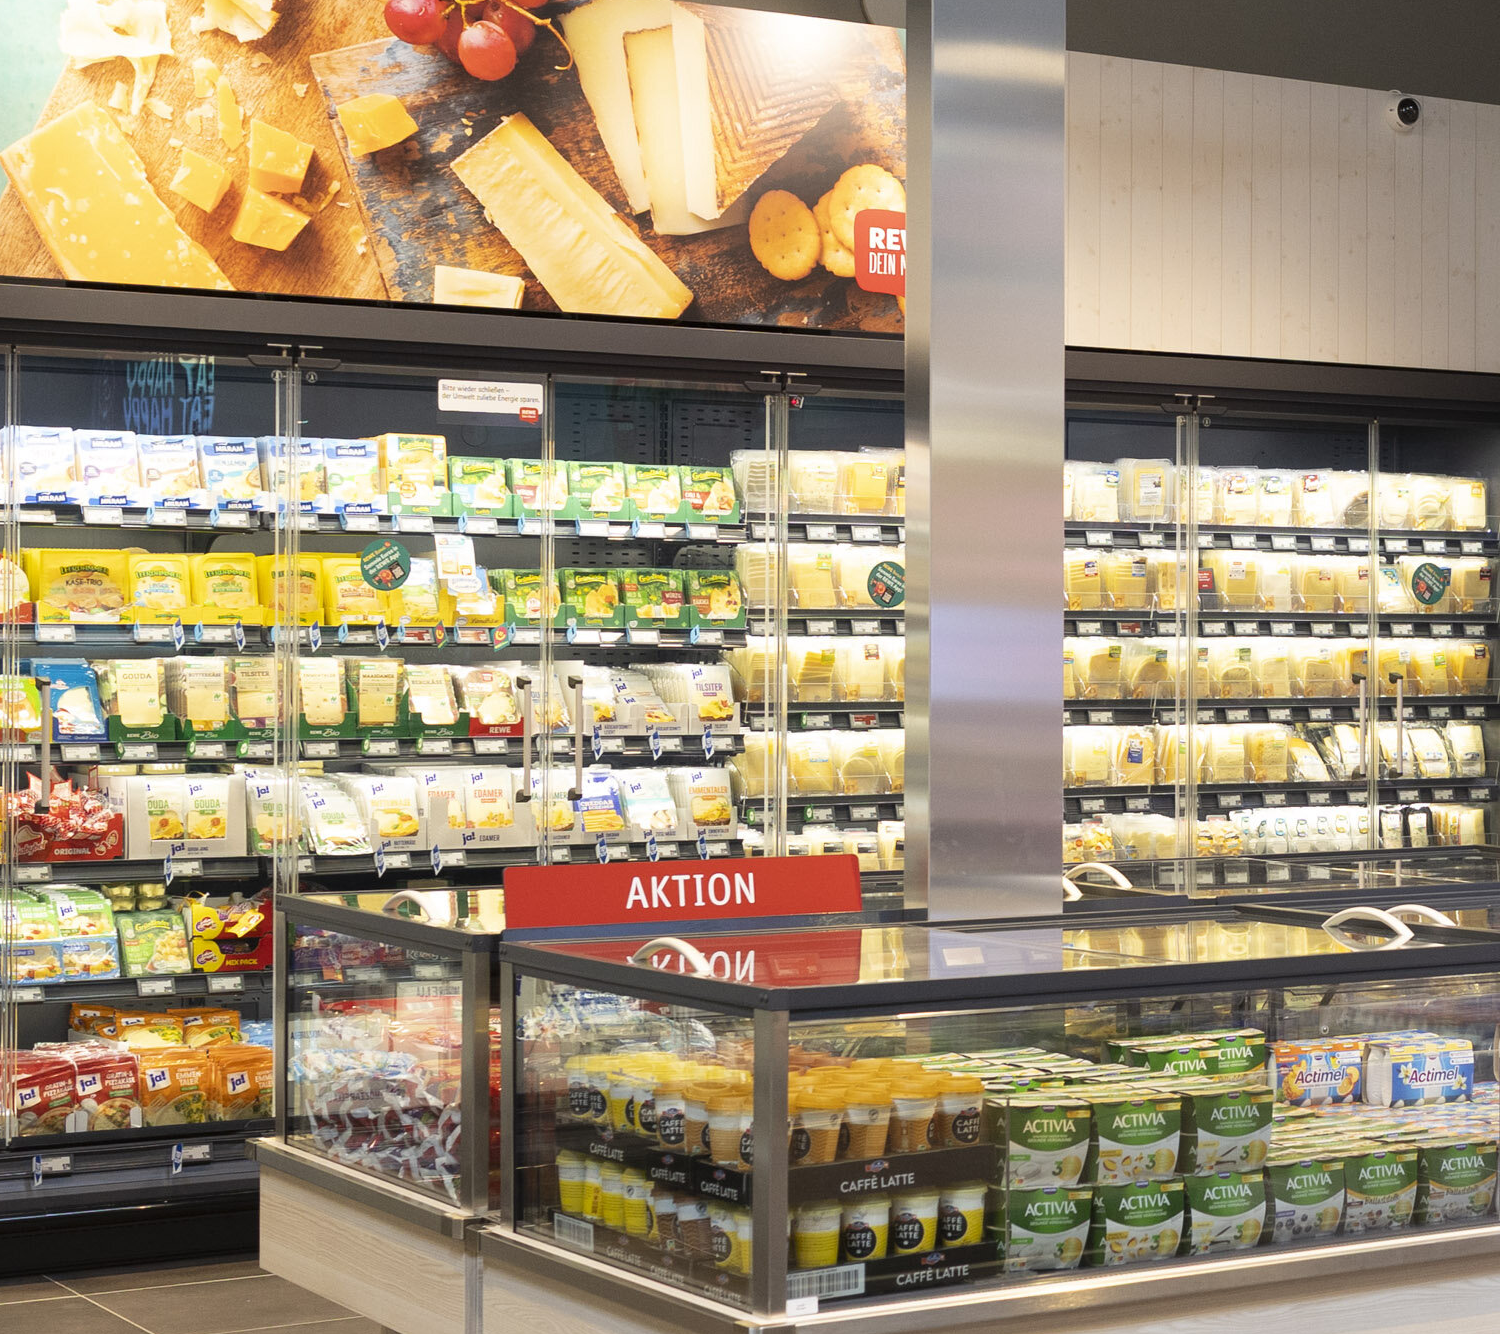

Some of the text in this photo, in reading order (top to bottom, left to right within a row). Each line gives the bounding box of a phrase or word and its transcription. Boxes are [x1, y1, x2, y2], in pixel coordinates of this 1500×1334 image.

[869, 251, 896, 275] DEIN
[695, 682, 724, 693] TILSITER
[53, 847, 91, 856] ORIGINAL
[626, 872, 757, 910] AKTION
[1163, 1057, 1207, 1075] ACTIVIA
[1408, 1066, 1459, 1084] Actimel
[79, 1075, 98, 1093] ja!
[149, 1070, 170, 1088] ja!
[228, 1074, 248, 1091] ja!
[1295, 1066, 1346, 1087] Actimel
[1111, 1111, 1167, 1129] ACTIVIA
[1210, 1104, 1261, 1122] ACTIVIA
[1022, 1116, 1076, 1134] ACTIVIA
[1358, 1163, 1404, 1181] ACTIVIA
[1440, 1156, 1486, 1172] ACTIVIA
[840, 1171, 916, 1193] CAFFÈ LATTE
[1285, 1172, 1333, 1190] ACTIVIA
[1203, 1183, 1253, 1201] ACTIVIA
[1024, 1201, 1076, 1218] ACTIVIA
[1119, 1193, 1171, 1211] ACTIVIA
[896, 1264, 970, 1286] CAFFÈ LATTE
